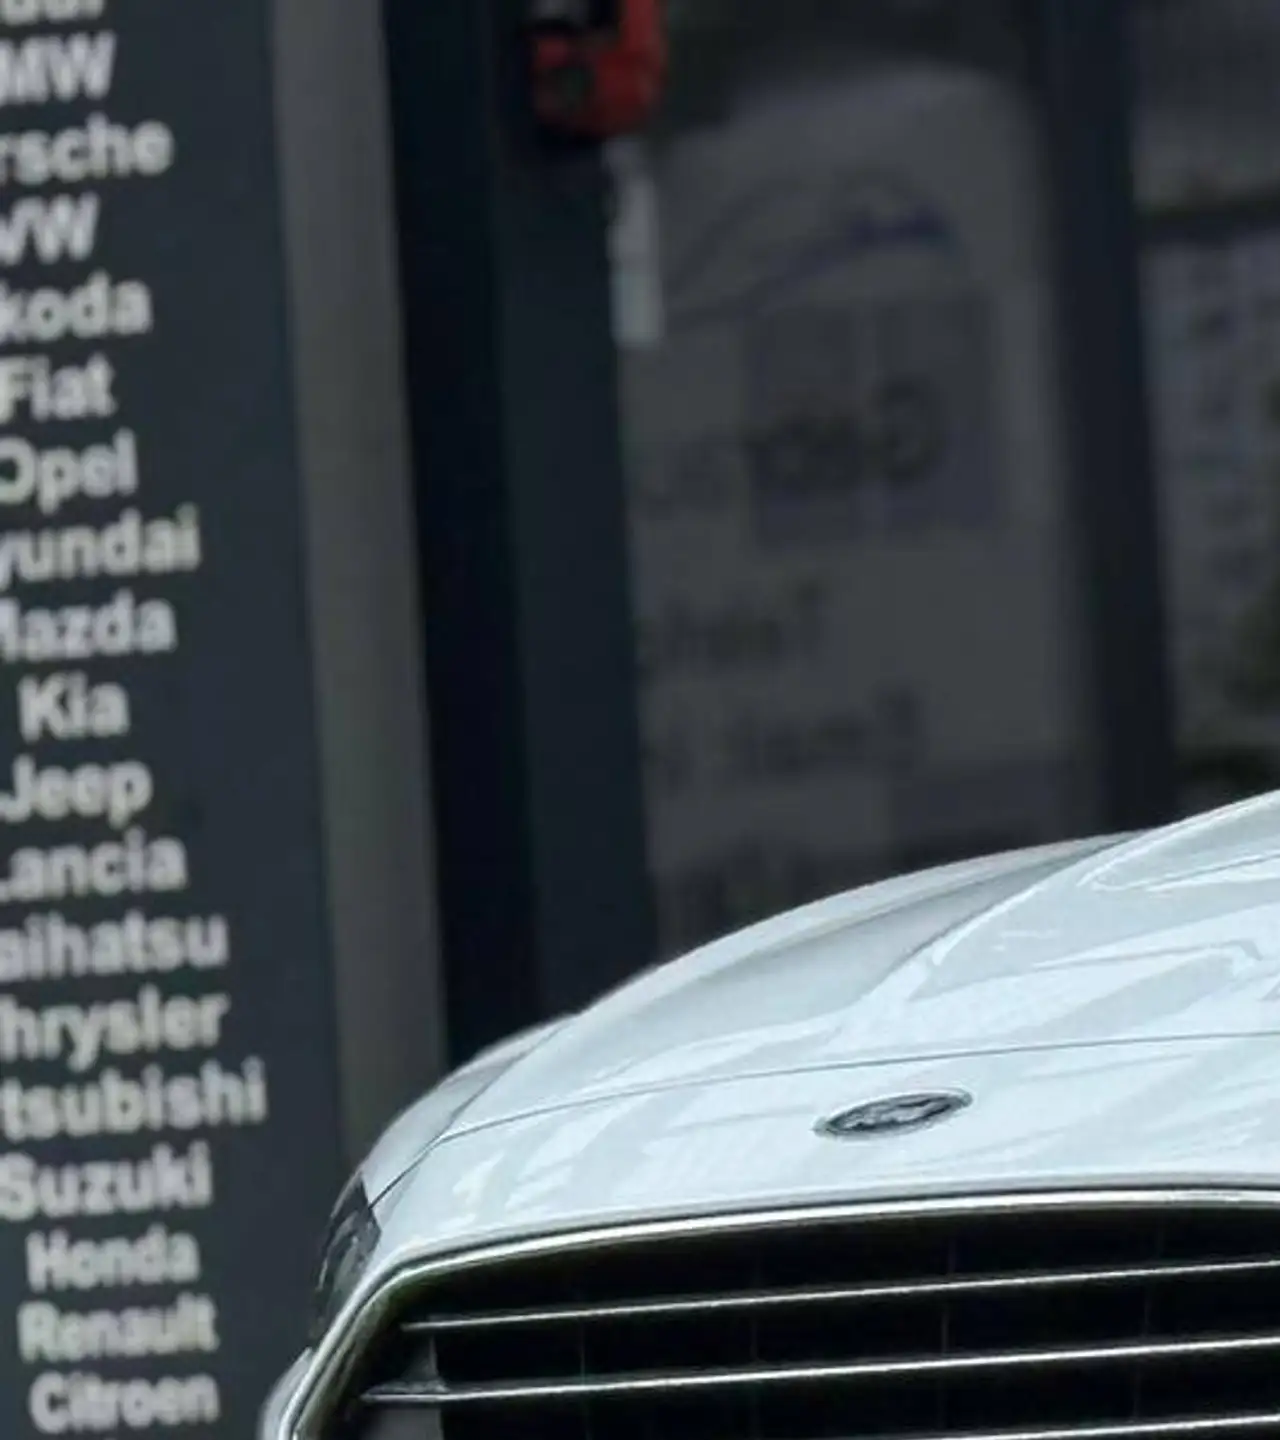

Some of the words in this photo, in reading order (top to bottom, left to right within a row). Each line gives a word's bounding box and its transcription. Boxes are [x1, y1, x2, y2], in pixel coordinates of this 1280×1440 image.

[0, 355, 116, 424] Fiat
[18, 672, 130, 741] Kia
[0, 755, 153, 827] Jeep
[0, 1141, 212, 1221] Suzuki
[26, 1224, 201, 1291] Honda
[17, 1292, 219, 1363] Renault
